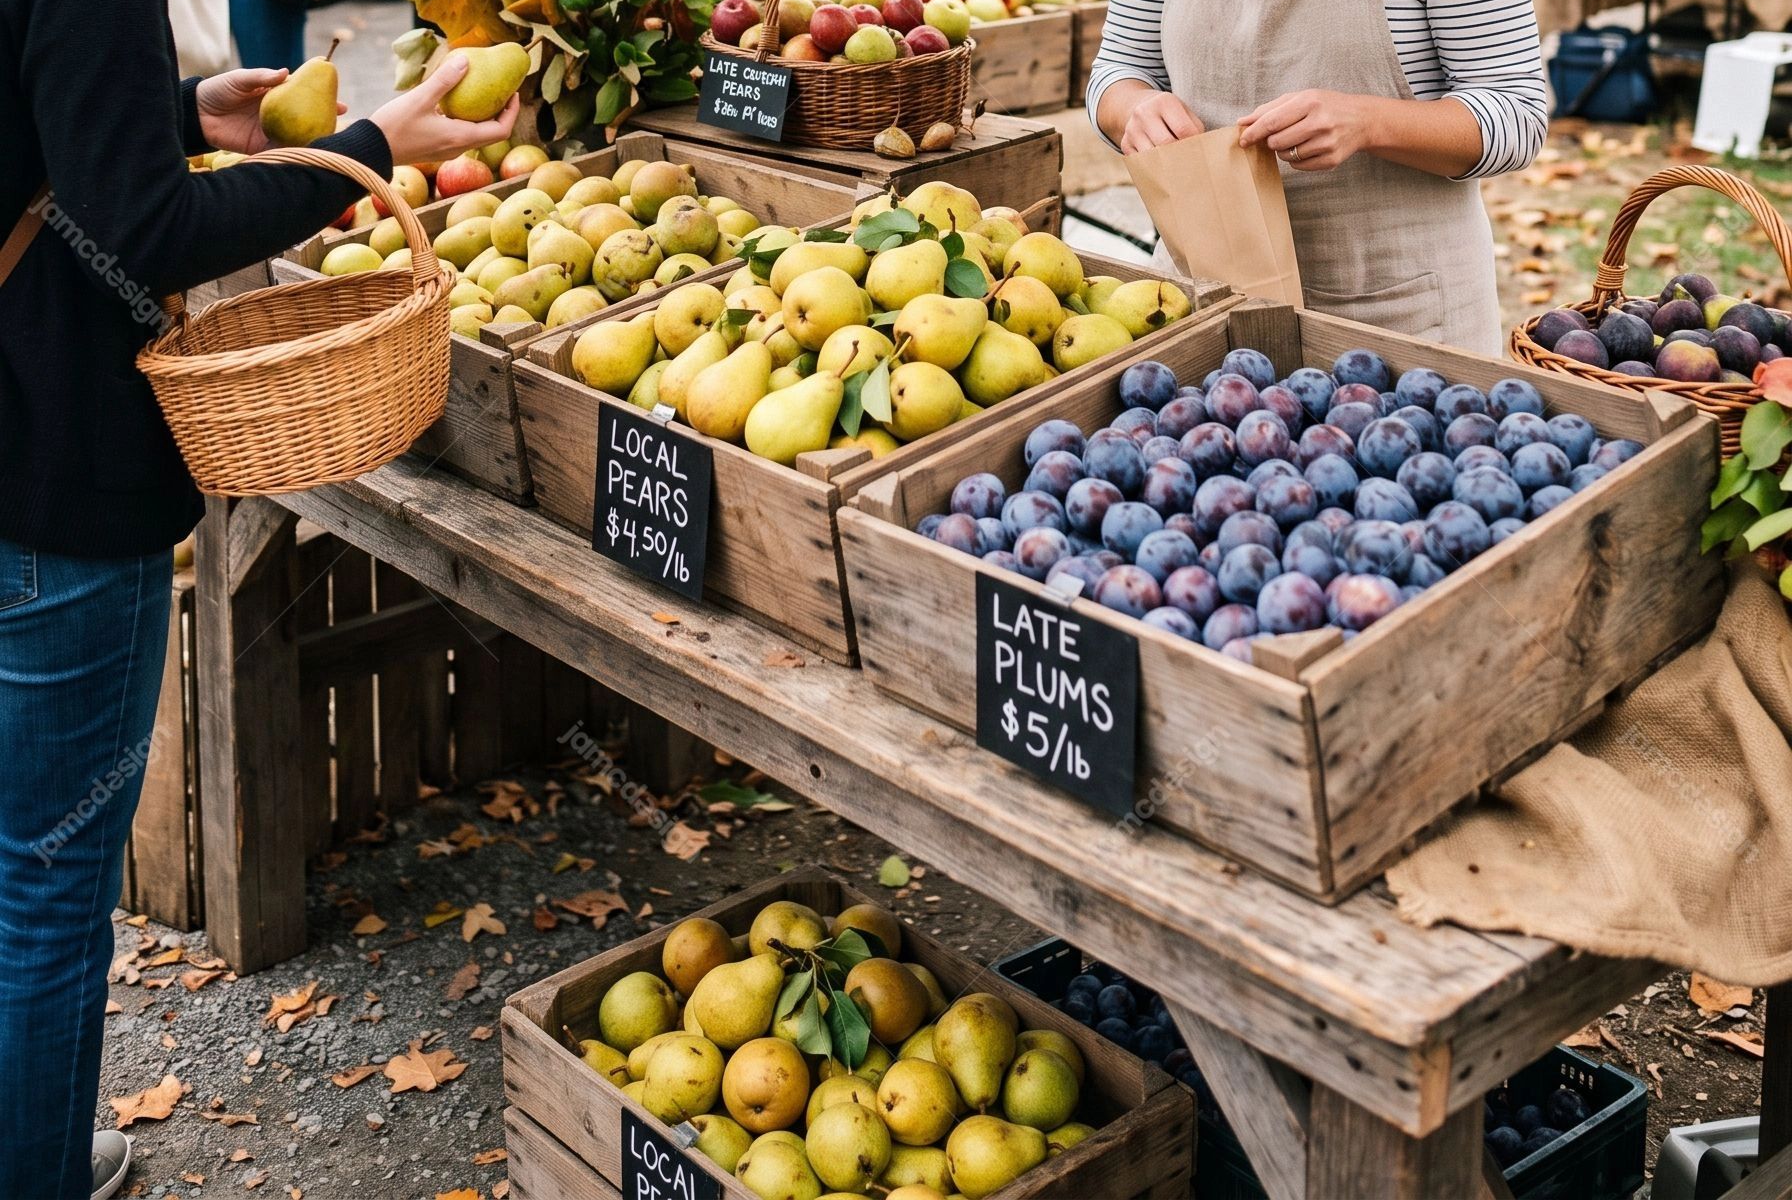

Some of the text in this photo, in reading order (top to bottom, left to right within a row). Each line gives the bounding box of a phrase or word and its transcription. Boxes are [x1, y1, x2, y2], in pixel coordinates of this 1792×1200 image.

[709, 57, 738, 77] LATE
[722, 80, 761, 101] PEARS
[610, 419, 688, 481] LOCAL
[608, 460, 689, 528] PEARS
[606, 506, 690, 583] $4.50/lb
[993, 593, 1081, 662] LATE
[995, 640, 1114, 732] PLUMS
[1001, 698, 1091, 780] $5/lb
